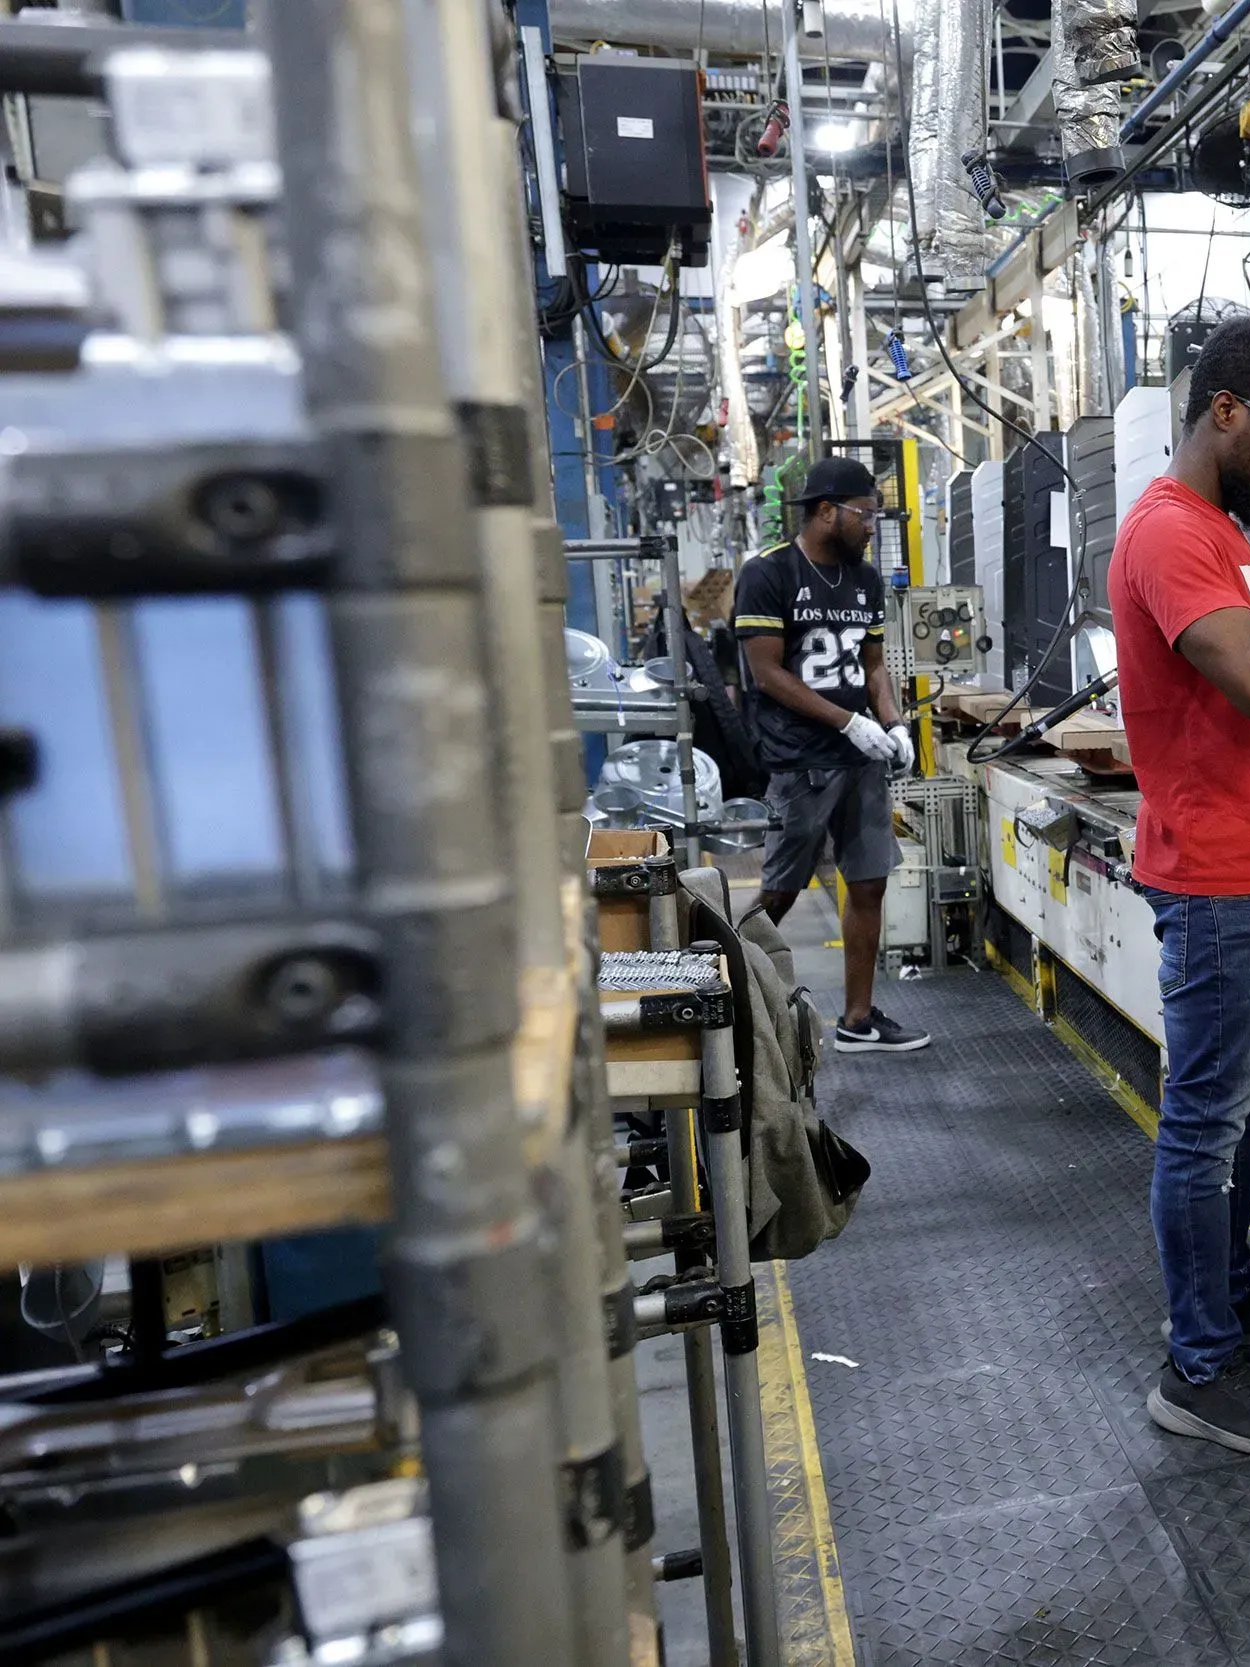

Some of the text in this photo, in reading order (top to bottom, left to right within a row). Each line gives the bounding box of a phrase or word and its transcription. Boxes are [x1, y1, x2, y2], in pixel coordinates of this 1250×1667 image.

[793, 608, 873, 624] LOS ANGELES
[801, 626, 867, 690] 23
